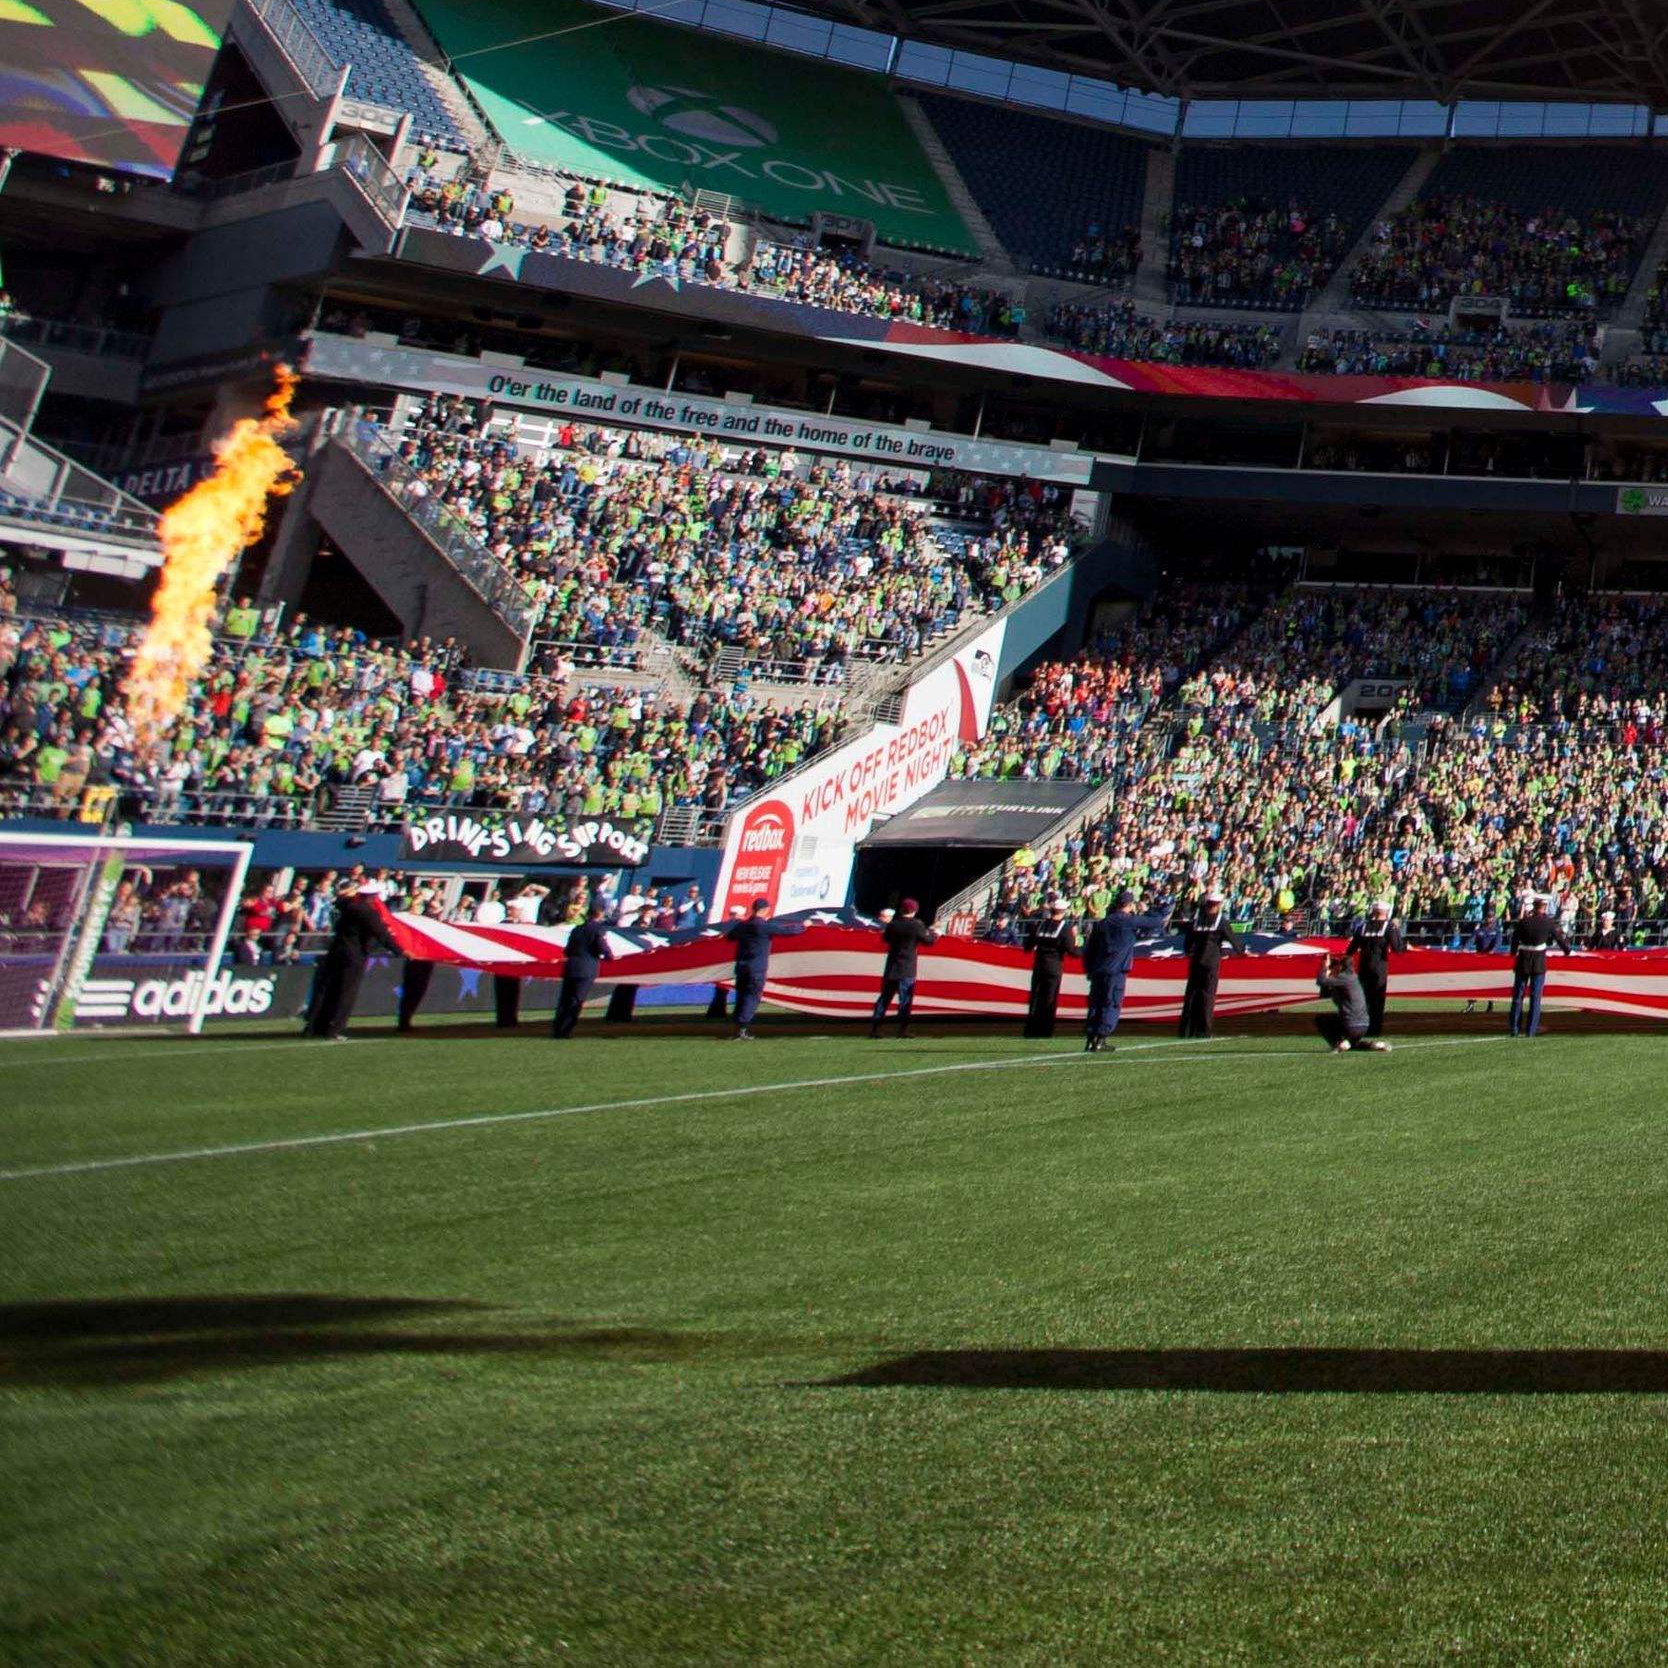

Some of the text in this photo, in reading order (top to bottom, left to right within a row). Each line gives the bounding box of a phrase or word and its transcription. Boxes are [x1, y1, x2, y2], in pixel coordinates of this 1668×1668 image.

[340, 103, 398, 126] 300
[763, 159, 937, 214] ONE
[490, 374, 956, 460] O'er the land of the free and the home of the brave
[802, 706, 949, 825] KICK OFF REDBOX
[845, 772, 898, 833] MOVIE
[411, 816, 491, 857] DRINK
[557, 821, 649, 862] SUPPORT
[742, 822, 785, 852] redbox
[133, 969, 274, 1016] adidas
